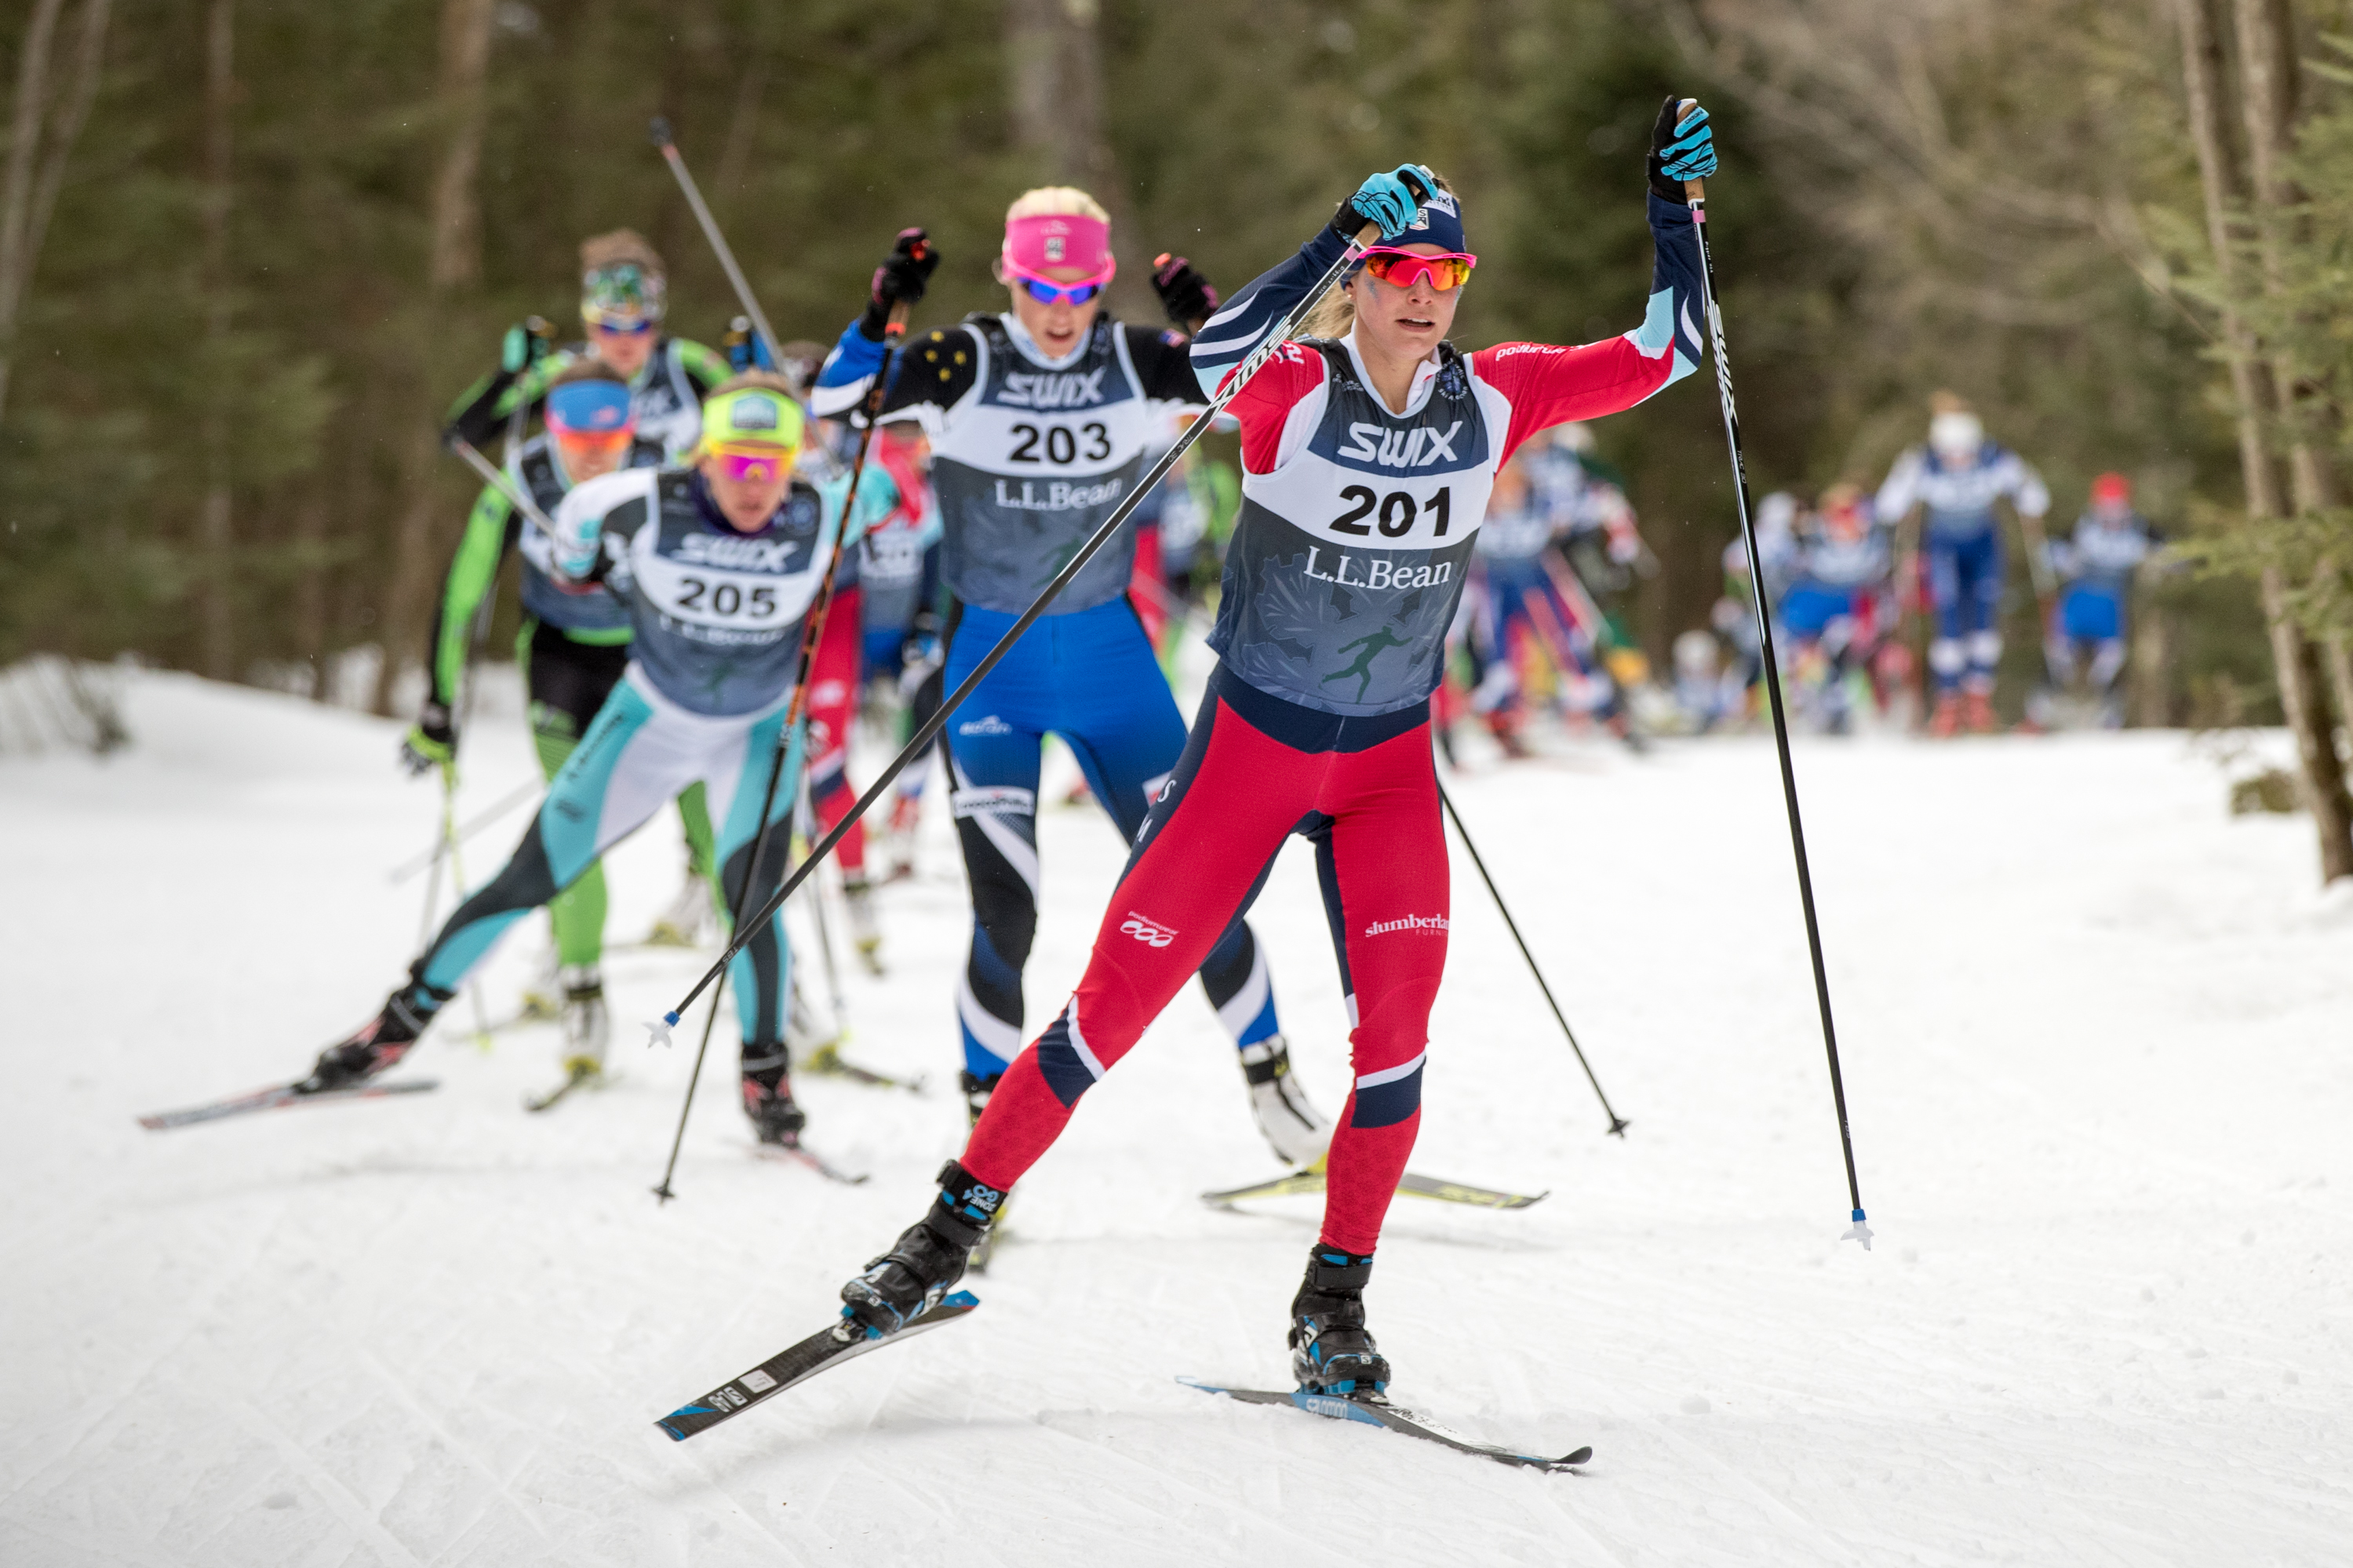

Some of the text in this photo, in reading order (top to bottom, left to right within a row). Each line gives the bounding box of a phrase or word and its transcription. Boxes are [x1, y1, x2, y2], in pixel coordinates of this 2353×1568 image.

[996, 366, 1107, 409] SWIX
[1209, 318, 1291, 420] SWIX
[1011, 423, 1110, 464] 203
[1337, 420, 1463, 467] SWIX
[995, 478, 1123, 510] L.L.Bean
[1328, 485, 1451, 537] 201
[1303, 545, 1452, 590] L.L.Bean
[677, 578, 775, 617] 205
